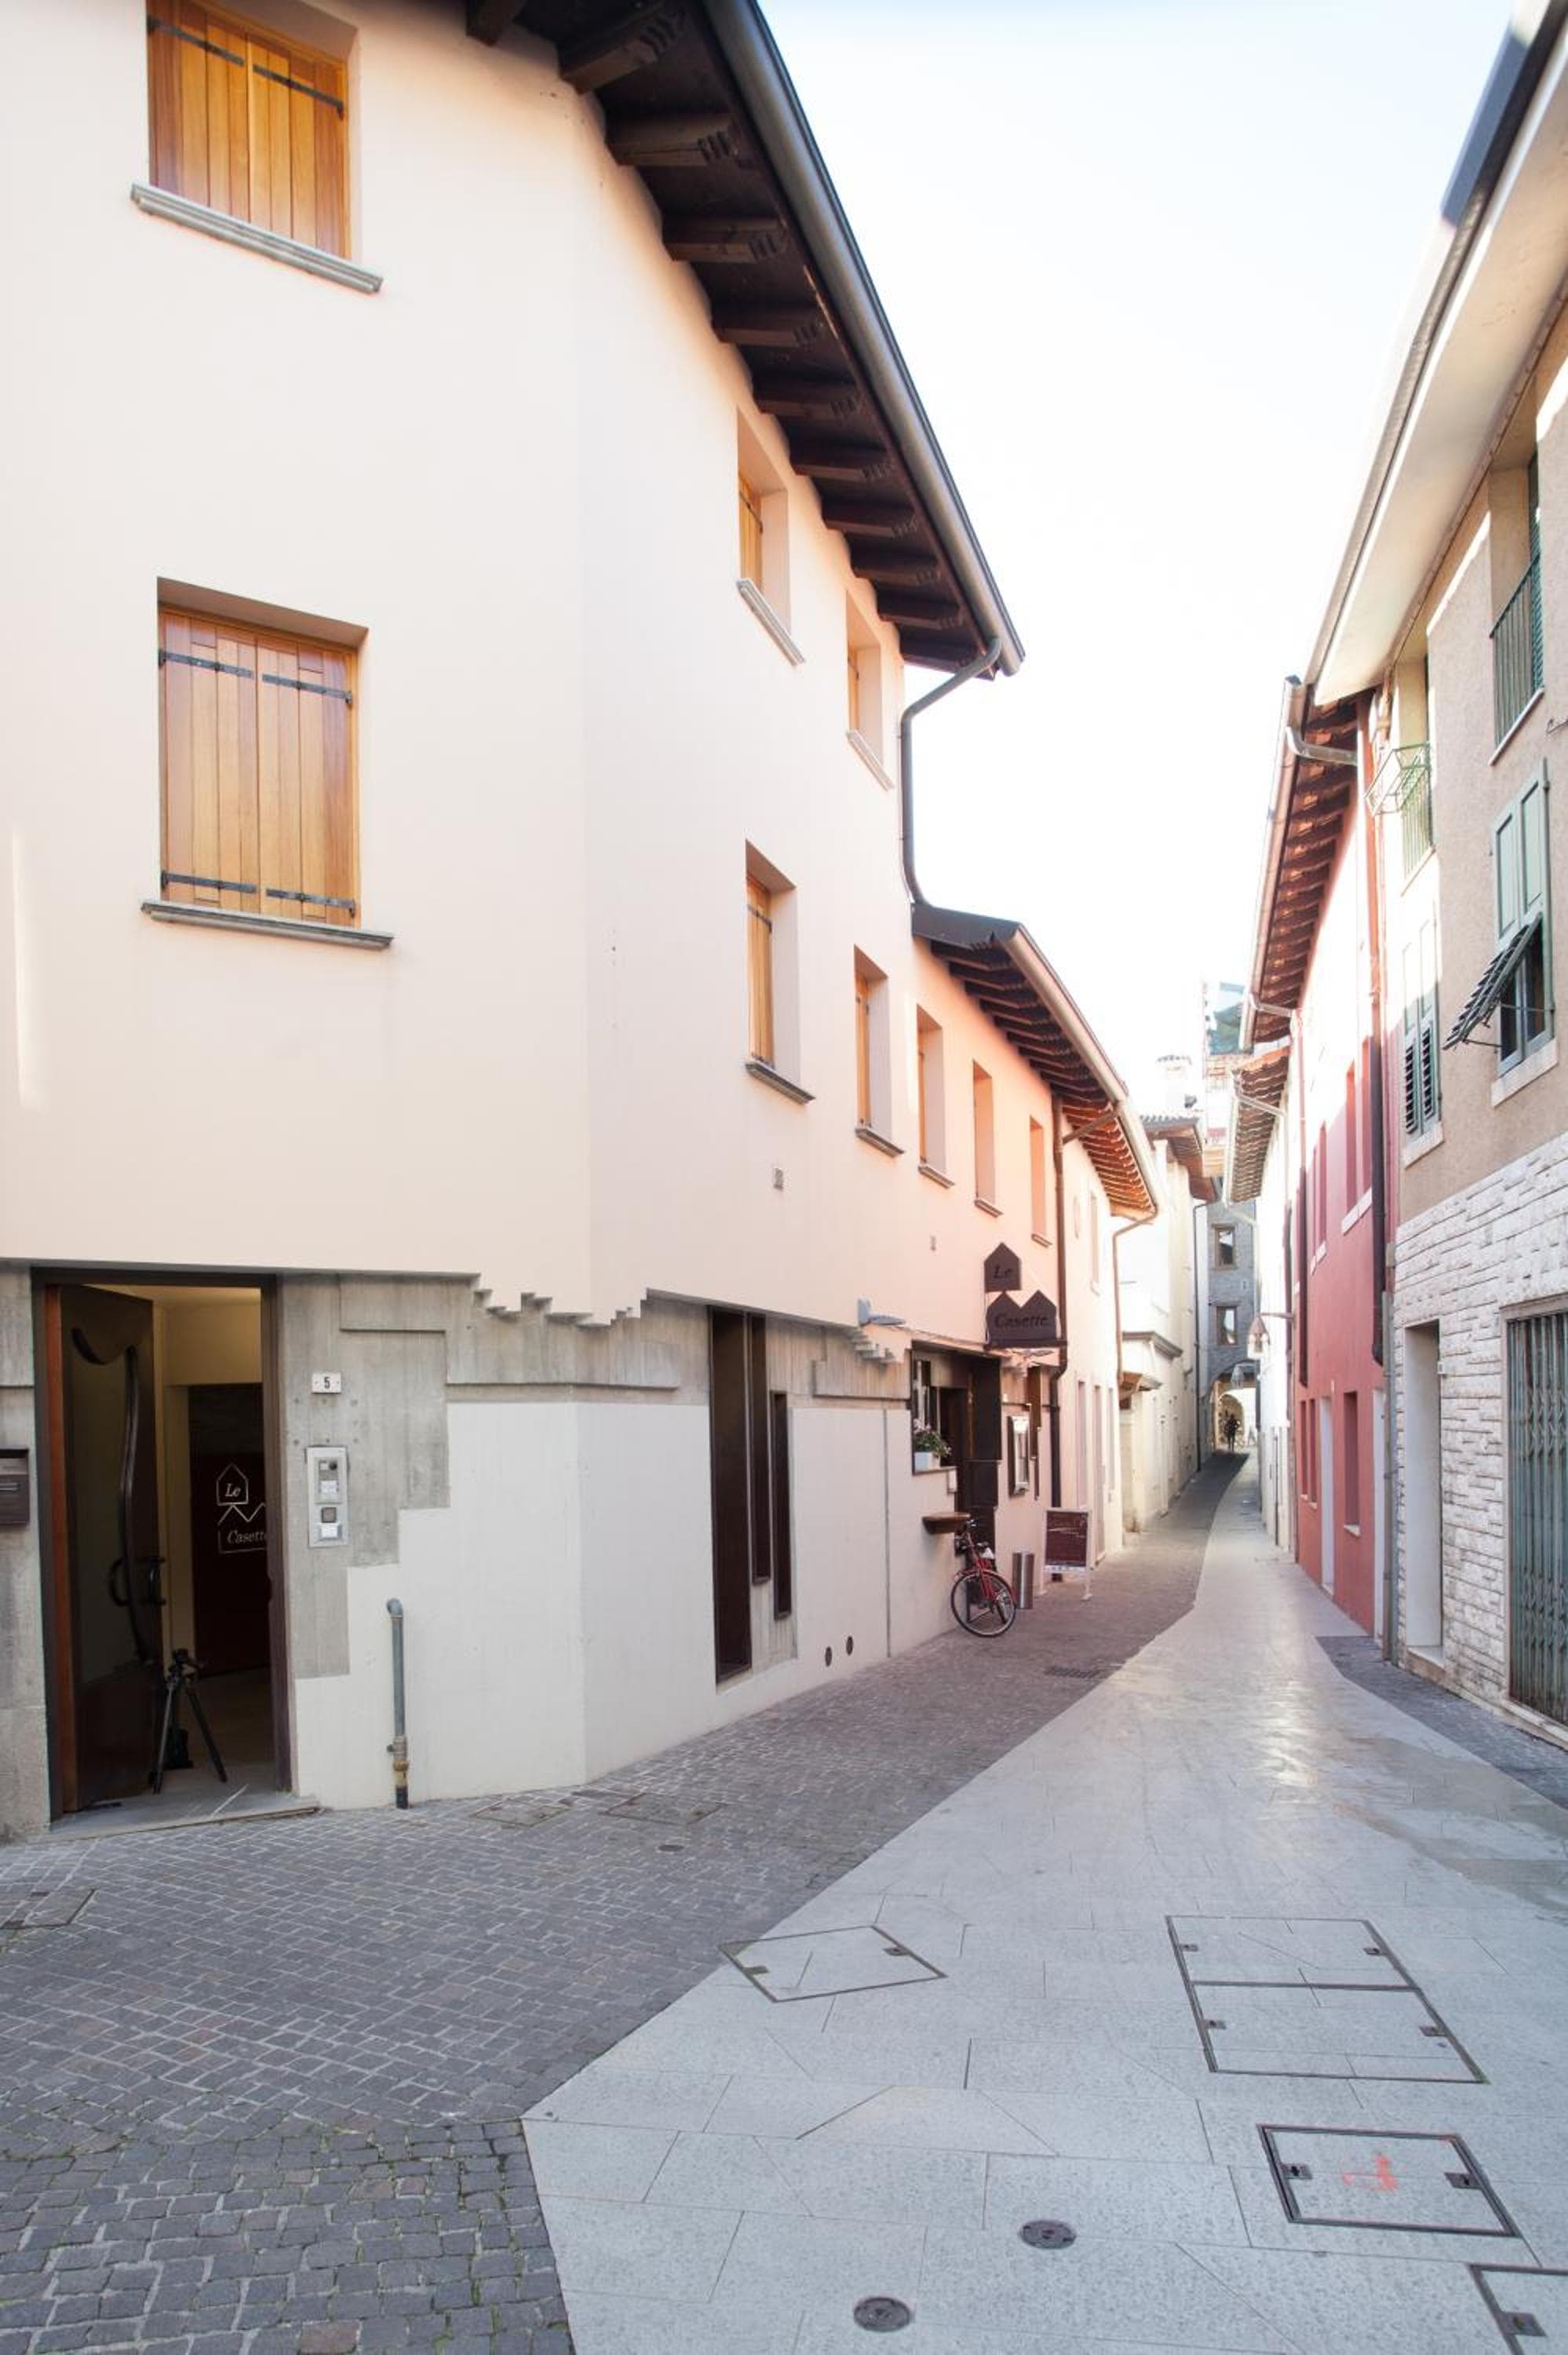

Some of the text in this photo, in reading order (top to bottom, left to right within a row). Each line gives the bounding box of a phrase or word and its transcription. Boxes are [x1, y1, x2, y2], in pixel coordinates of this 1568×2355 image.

[993, 1265, 1013, 1279] Le
[994, 1313, 1048, 1329] Casette
[324, 1376, 331, 1389] 5
[224, 1483, 241, 1497] Le
[227, 1529, 266, 1544] Casett
